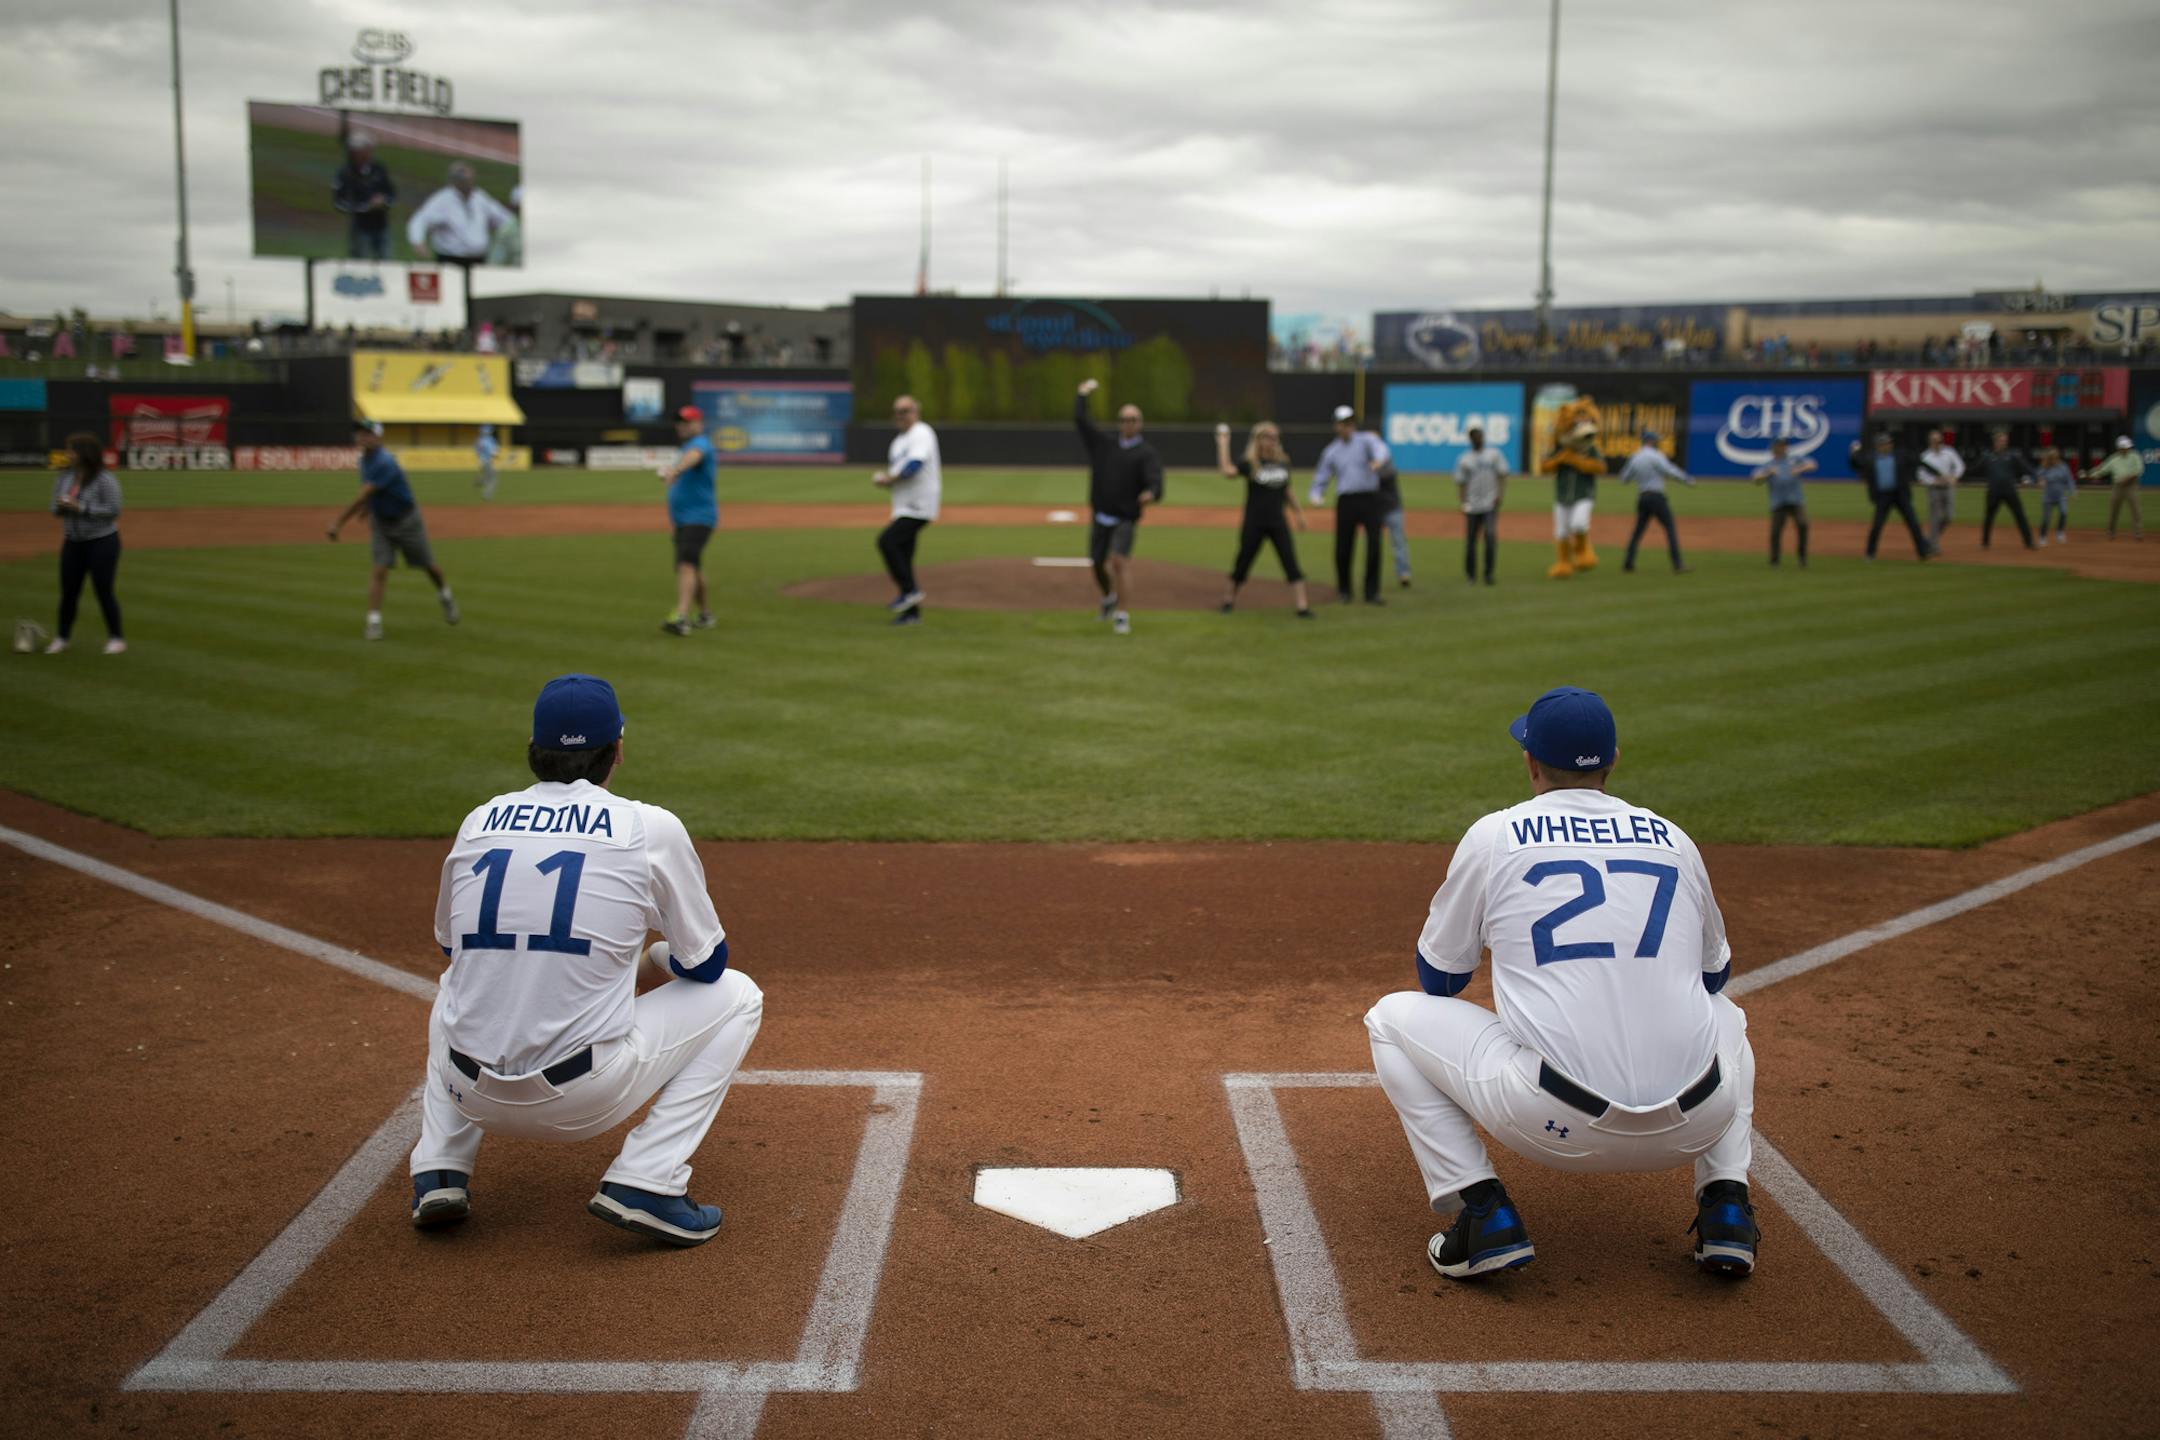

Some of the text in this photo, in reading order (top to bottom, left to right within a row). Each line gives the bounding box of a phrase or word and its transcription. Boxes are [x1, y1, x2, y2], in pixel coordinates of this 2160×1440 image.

[319, 66, 453, 114] CHS FIELD
[2092, 305, 2160, 345] SP
[1872, 370, 2024, 407] KINKY
[1387, 412, 1511, 445] ECOLAB
[1728, 394, 1821, 439] CHS
[127, 446, 231, 471] LOFFLER
[234, 446, 252, 470] IT
[560, 734, 587, 746] Saints
[1575, 754, 1601, 767] Saints
[483, 804, 613, 838] MEDINA
[1511, 815, 1673, 849] WHEELER
[462, 847, 592, 957] 11
[1522, 859, 1679, 967] 27
